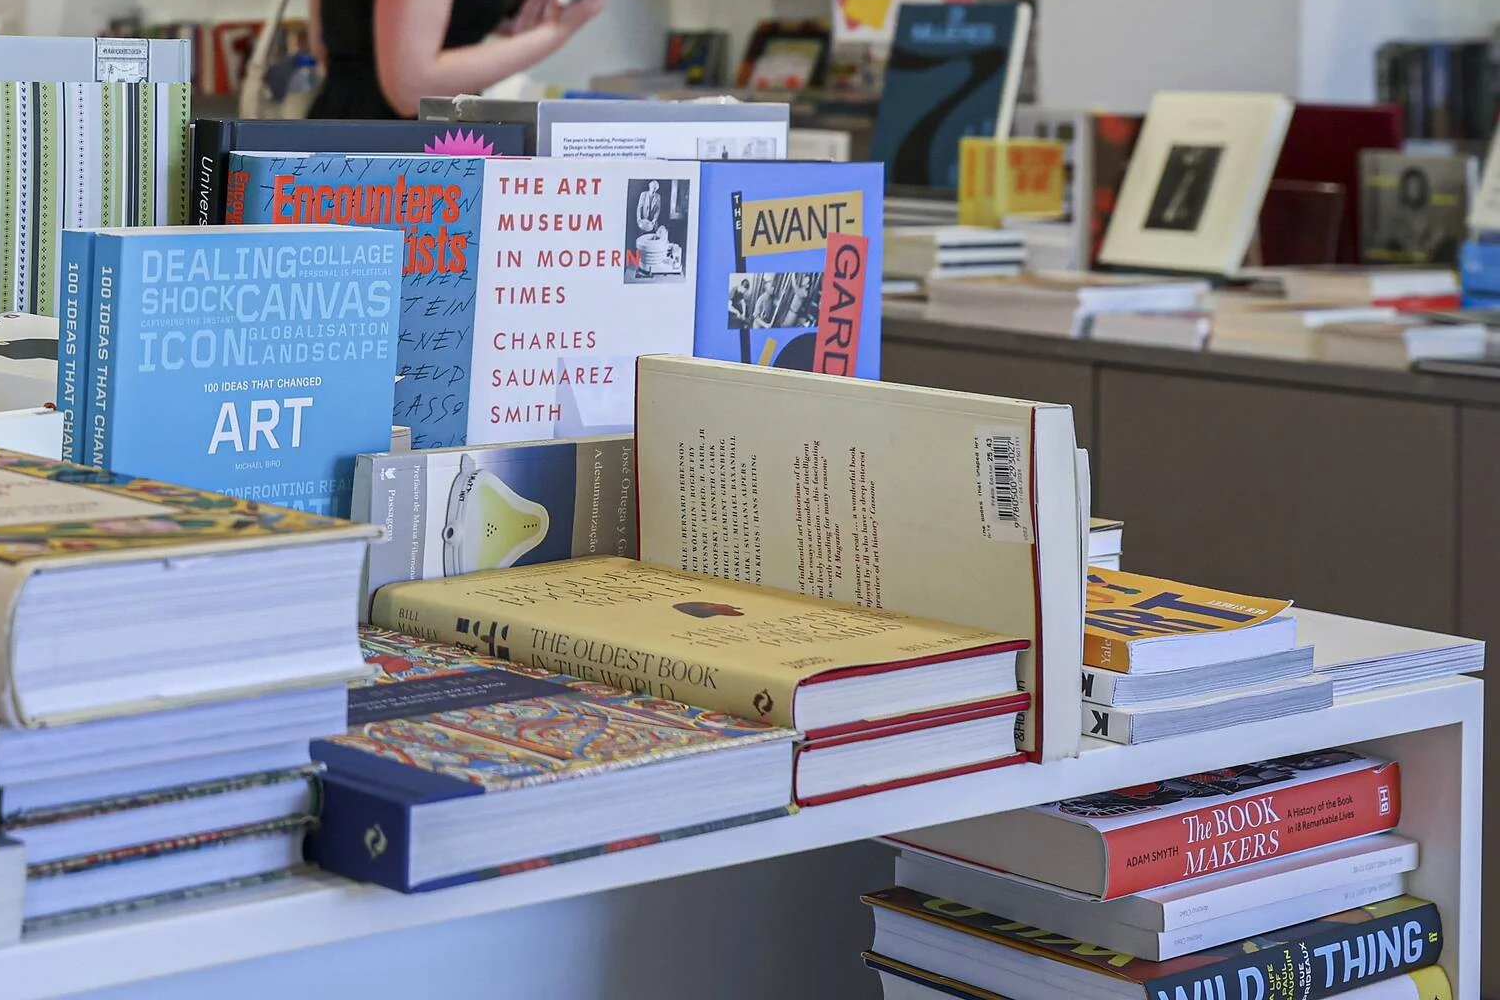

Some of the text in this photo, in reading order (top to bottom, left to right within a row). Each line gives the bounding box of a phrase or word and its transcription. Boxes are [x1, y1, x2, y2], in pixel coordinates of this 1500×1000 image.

[274, 174, 462, 225] Encounters
[499, 177, 602, 195] THE ART
[498, 214, 603, 232] MUSEUM
[733, 195, 742, 231] THE
[750, 202, 855, 247] AVANT-
[299, 244, 394, 267] COLLAGE
[401, 226, 468, 275] ists
[496, 249, 642, 268] IN MODERN
[141, 246, 298, 284] DEALING
[141, 285, 236, 315] SHOCK
[236, 281, 391, 322] CANVAS
[495, 286, 566, 305] TIMES
[249, 321, 389, 341] GLOBALISATION
[493, 330, 596, 351] CHARLES
[139, 327, 246, 372] ICON
[248, 340, 388, 366] LANDSCAPE
[63, 263, 78, 464] 100 IDEAS THAT CHAN
[93, 266, 112, 469] 100 IDEAS THAT CHAN
[492, 366, 613, 387] SAUMAREZ
[203, 376, 322, 393] 100 IDEAS THAT CHANGED
[207, 396, 313, 455] ART
[490, 404, 561, 424] SMITH
[235, 461, 263, 470] MICHAEL
[618, 446, 631, 522] José Ortega
[386, 489, 397, 542] Passagens
[399, 608, 420, 621] BILL
[531, 628, 718, 690] THE OLDEST BOOK
[1100, 639, 1112, 665] Yale
[1090, 709, 1109, 736] K
[1287, 795, 1353, 818] A History of the Book
[1181, 796, 1281, 845] The BOOK
[1302, 813, 1338, 830] Remarkable
[1339, 811, 1354, 822] Lives
[1126, 846, 1179, 868] ADAM SMYTH
[1182, 829, 1281, 877] MAKERS
[1314, 920, 1423, 989] THING
[1267, 963, 1275, 991] LIFE
